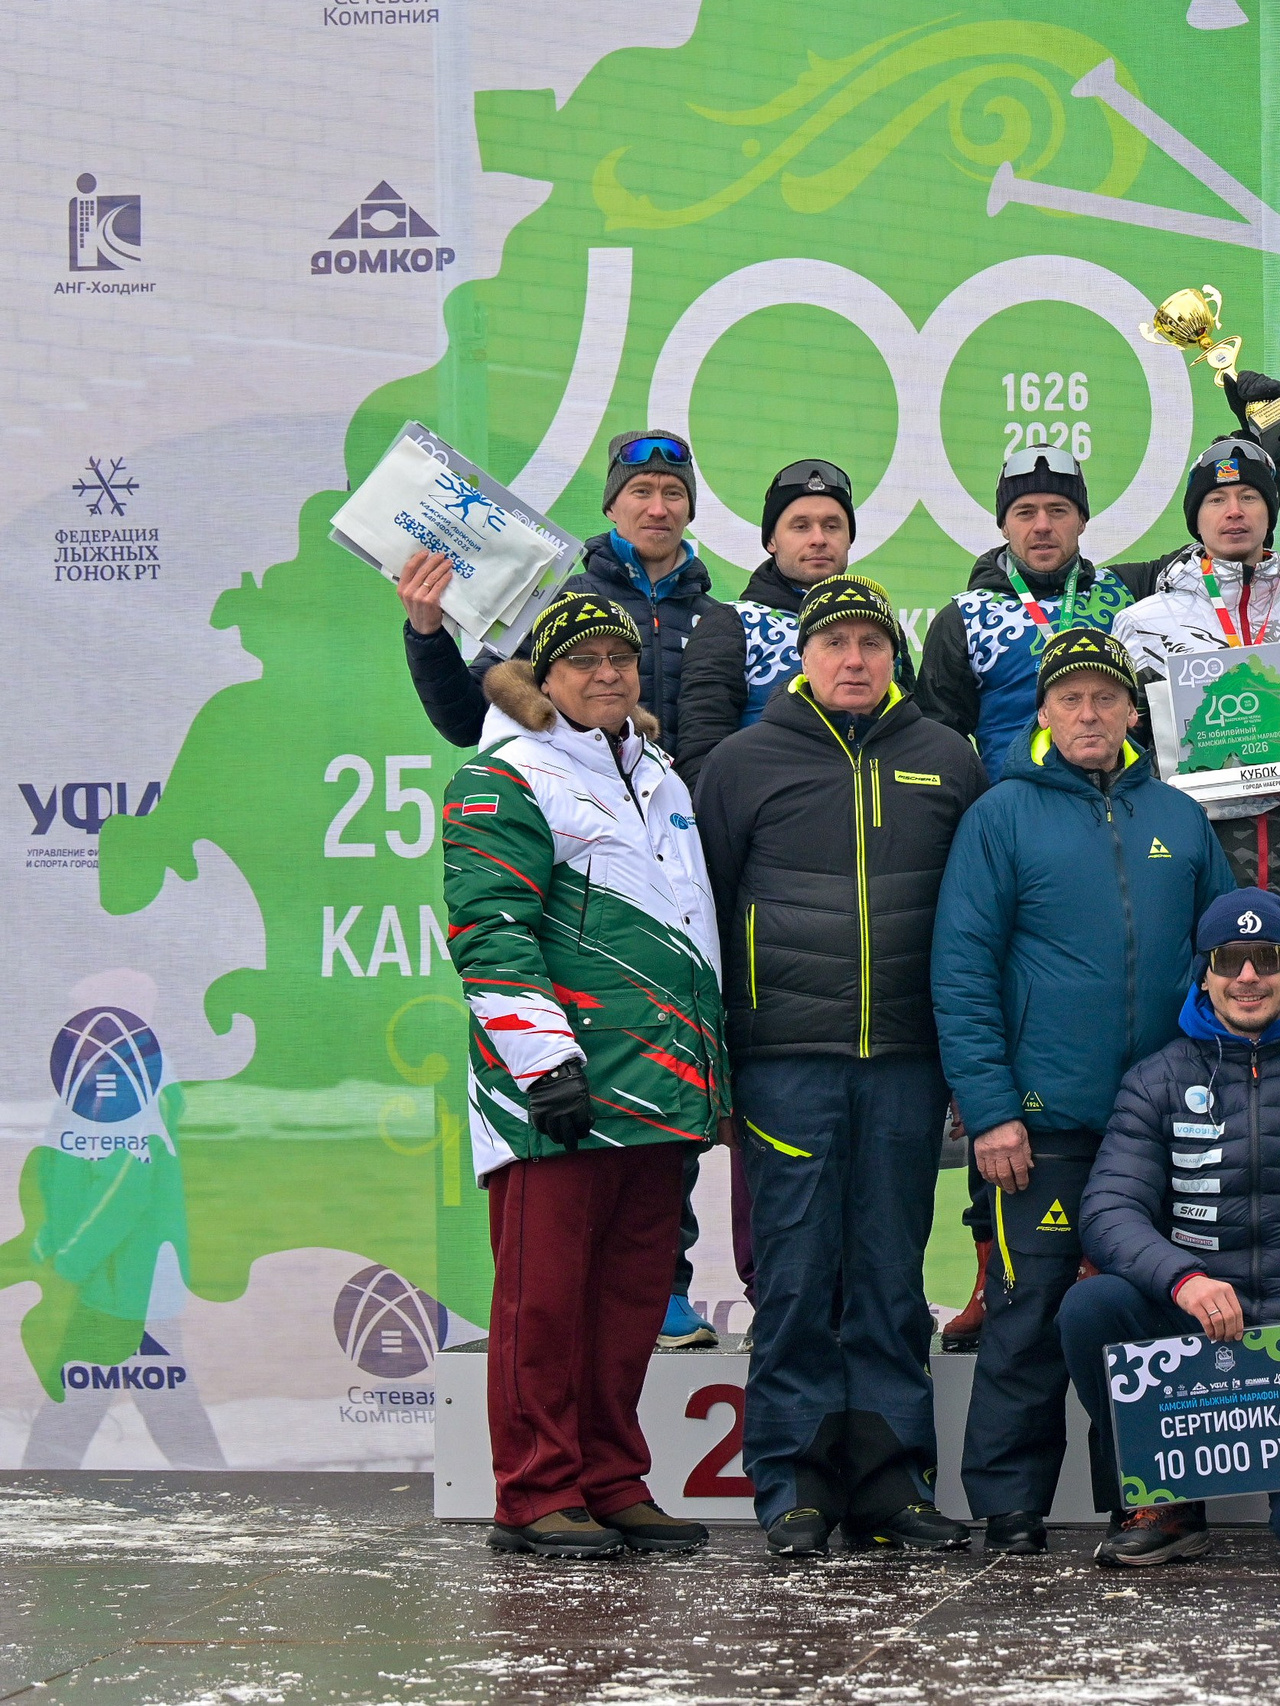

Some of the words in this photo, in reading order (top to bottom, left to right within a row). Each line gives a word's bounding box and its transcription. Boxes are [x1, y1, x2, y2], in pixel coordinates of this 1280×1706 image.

[324, 8, 439, 26] Компания
[54, 281, 157, 295] АНГ-Холдинг
[1002, 373, 1088, 411] 1626
[55, 529, 160, 544] ФЕДЕРАЦИЯ
[54, 546, 160, 563] ЛЫЖНЫХ
[55, 565, 133, 582] ГОНОК
[135, 565, 161, 581] РТ
[1197, 731, 1207, 740] 25
[1208, 726, 1257, 739] юбилейный
[1198, 737, 1225, 748] КАМСКИЙ
[1241, 741, 1269, 755] 2026
[1240, 764, 1279, 781] КУБОК
[324, 754, 436, 859] 25
[27, 849, 85, 857] УПРАВЛЕНИЕ
[34, 860, 68, 868] СПОРТА
[61, 1365, 187, 1390] ОМКОР
[1159, 1398, 1198, 1412] КАМСКИЙ
[1199, 1394, 1238, 1407] ЛЫЖНЫЙ
[1240, 1391, 1279, 1402] МАРАФОН
[684, 1384, 754, 1498] 2
[1154, 1450, 1185, 1481] 10
[1195, 1441, 1251, 1477] 000
